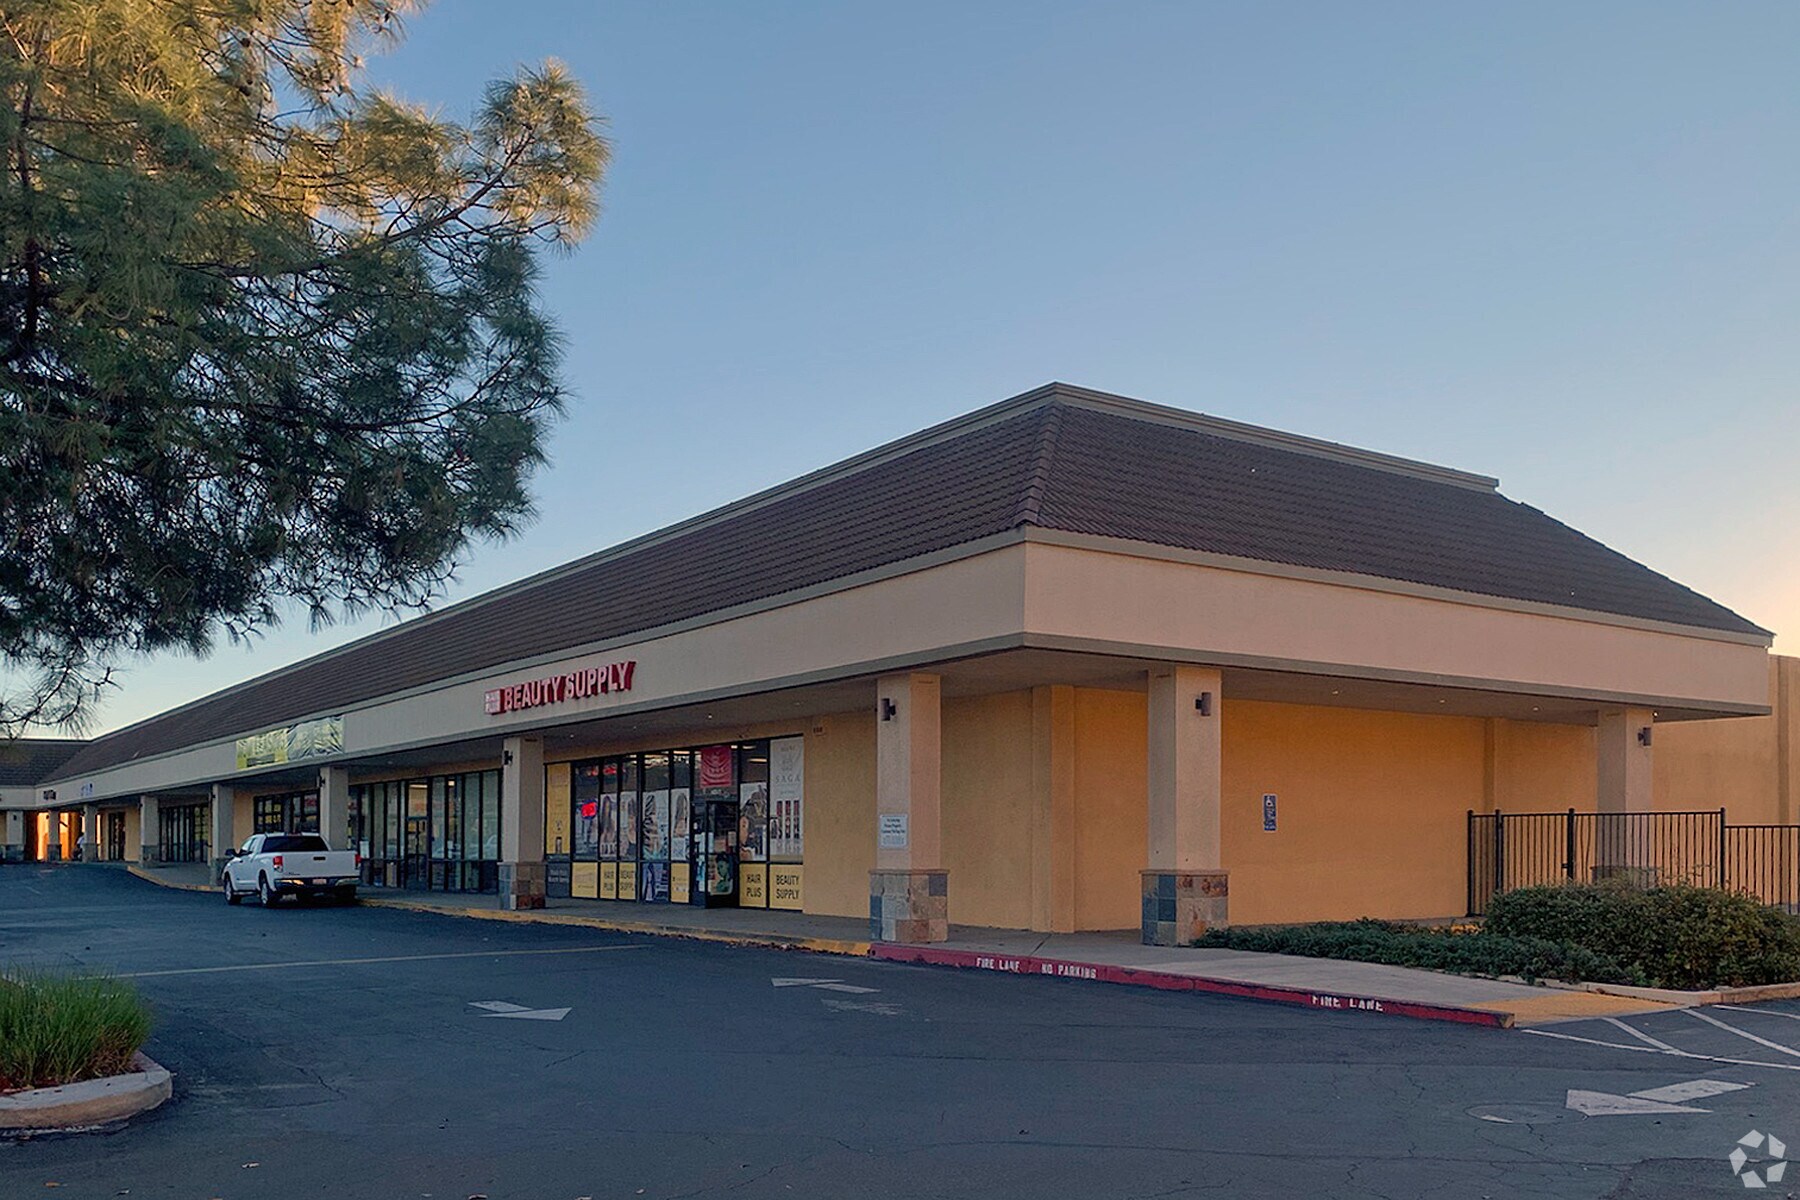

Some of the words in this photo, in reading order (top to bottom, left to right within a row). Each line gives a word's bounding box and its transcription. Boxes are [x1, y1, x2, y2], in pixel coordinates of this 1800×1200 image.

[504, 675, 563, 711] BEAUTY
[564, 661, 635, 700] SUPPLY
[746, 873, 761, 884] HAIR
[775, 874, 800, 886] BEAUTY
[746, 887, 762, 898] PLUS
[775, 888, 800, 900] SUPPLY
[976, 957, 995, 970] FIRE
[1041, 963, 1054, 974] NO
[1058, 964, 1097, 979] PARKING
